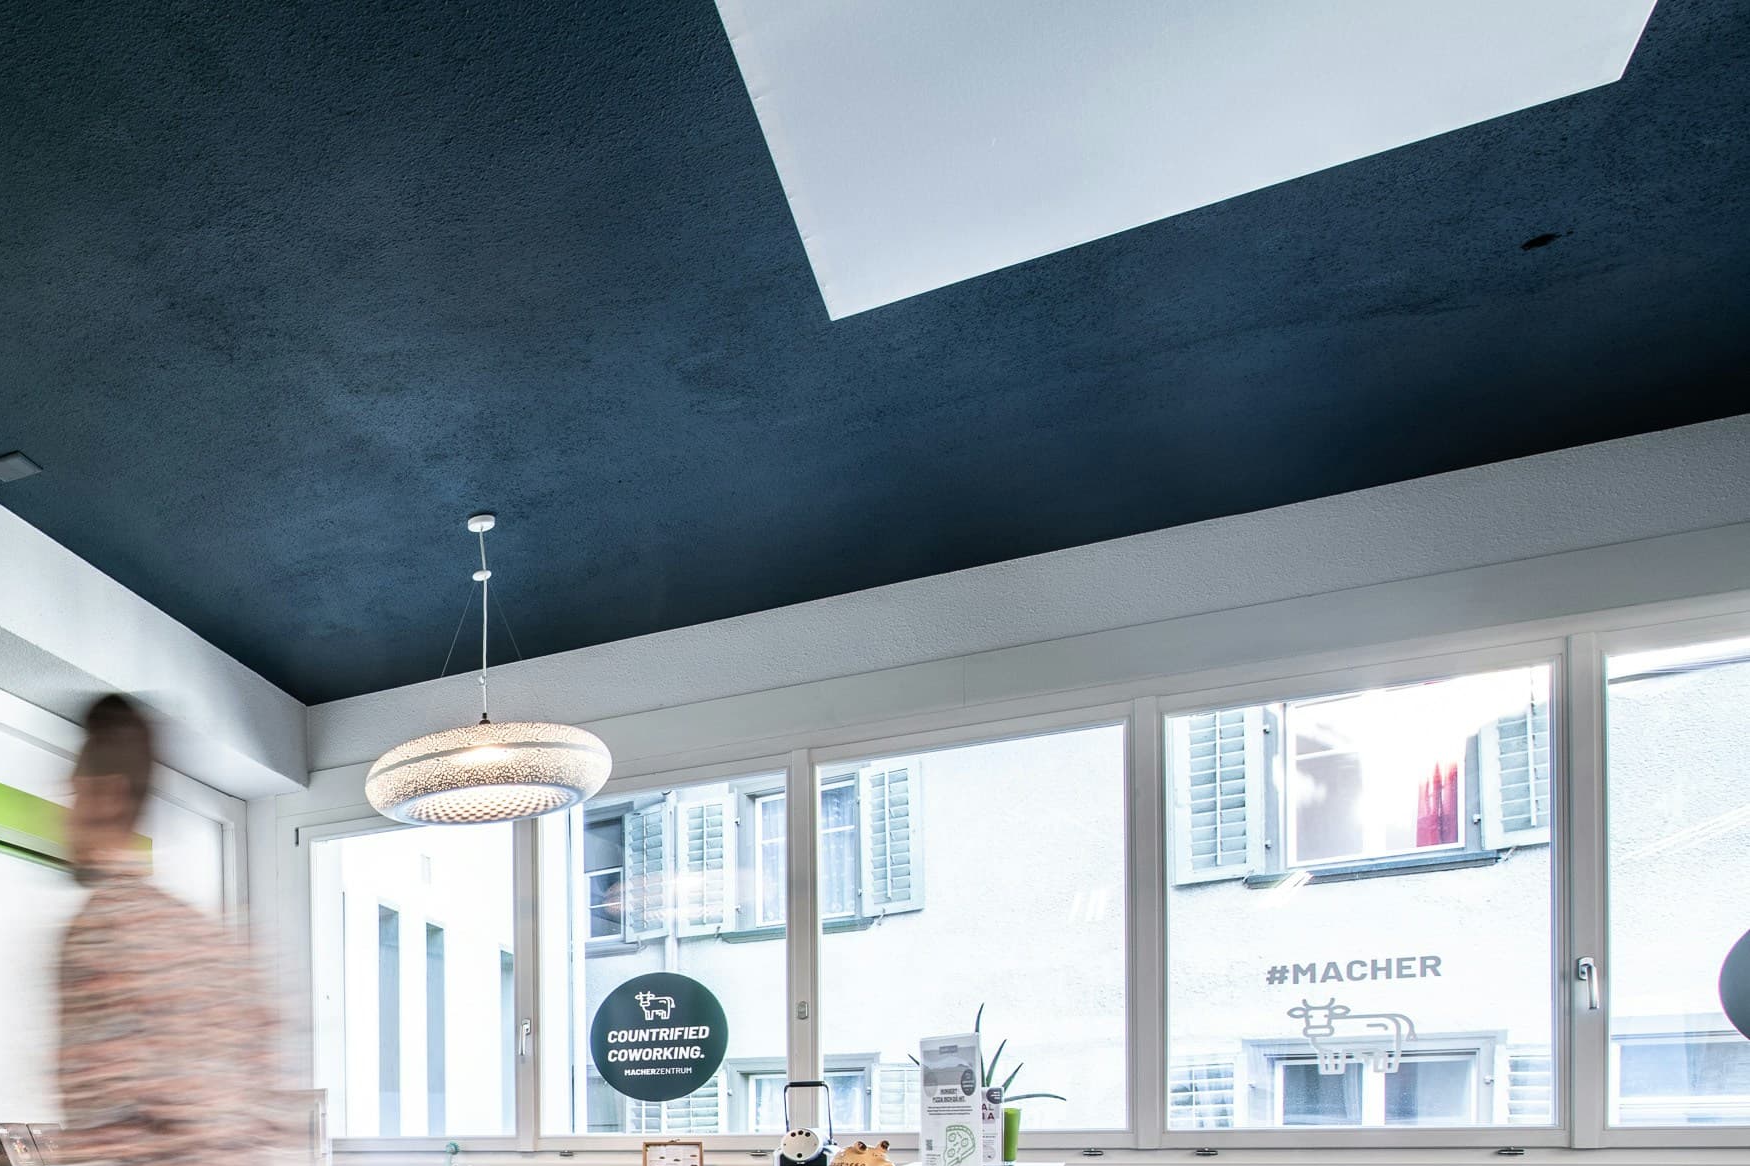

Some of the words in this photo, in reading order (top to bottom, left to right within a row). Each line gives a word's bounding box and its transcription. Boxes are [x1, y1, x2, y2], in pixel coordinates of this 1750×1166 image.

[1265, 955, 1442, 985] #MACHER
[607, 1025, 710, 1044] COUNTRIFIED
[607, 1046, 706, 1063] COWORKING.
[624, 1067, 692, 1076] MACHERZENTRUM
